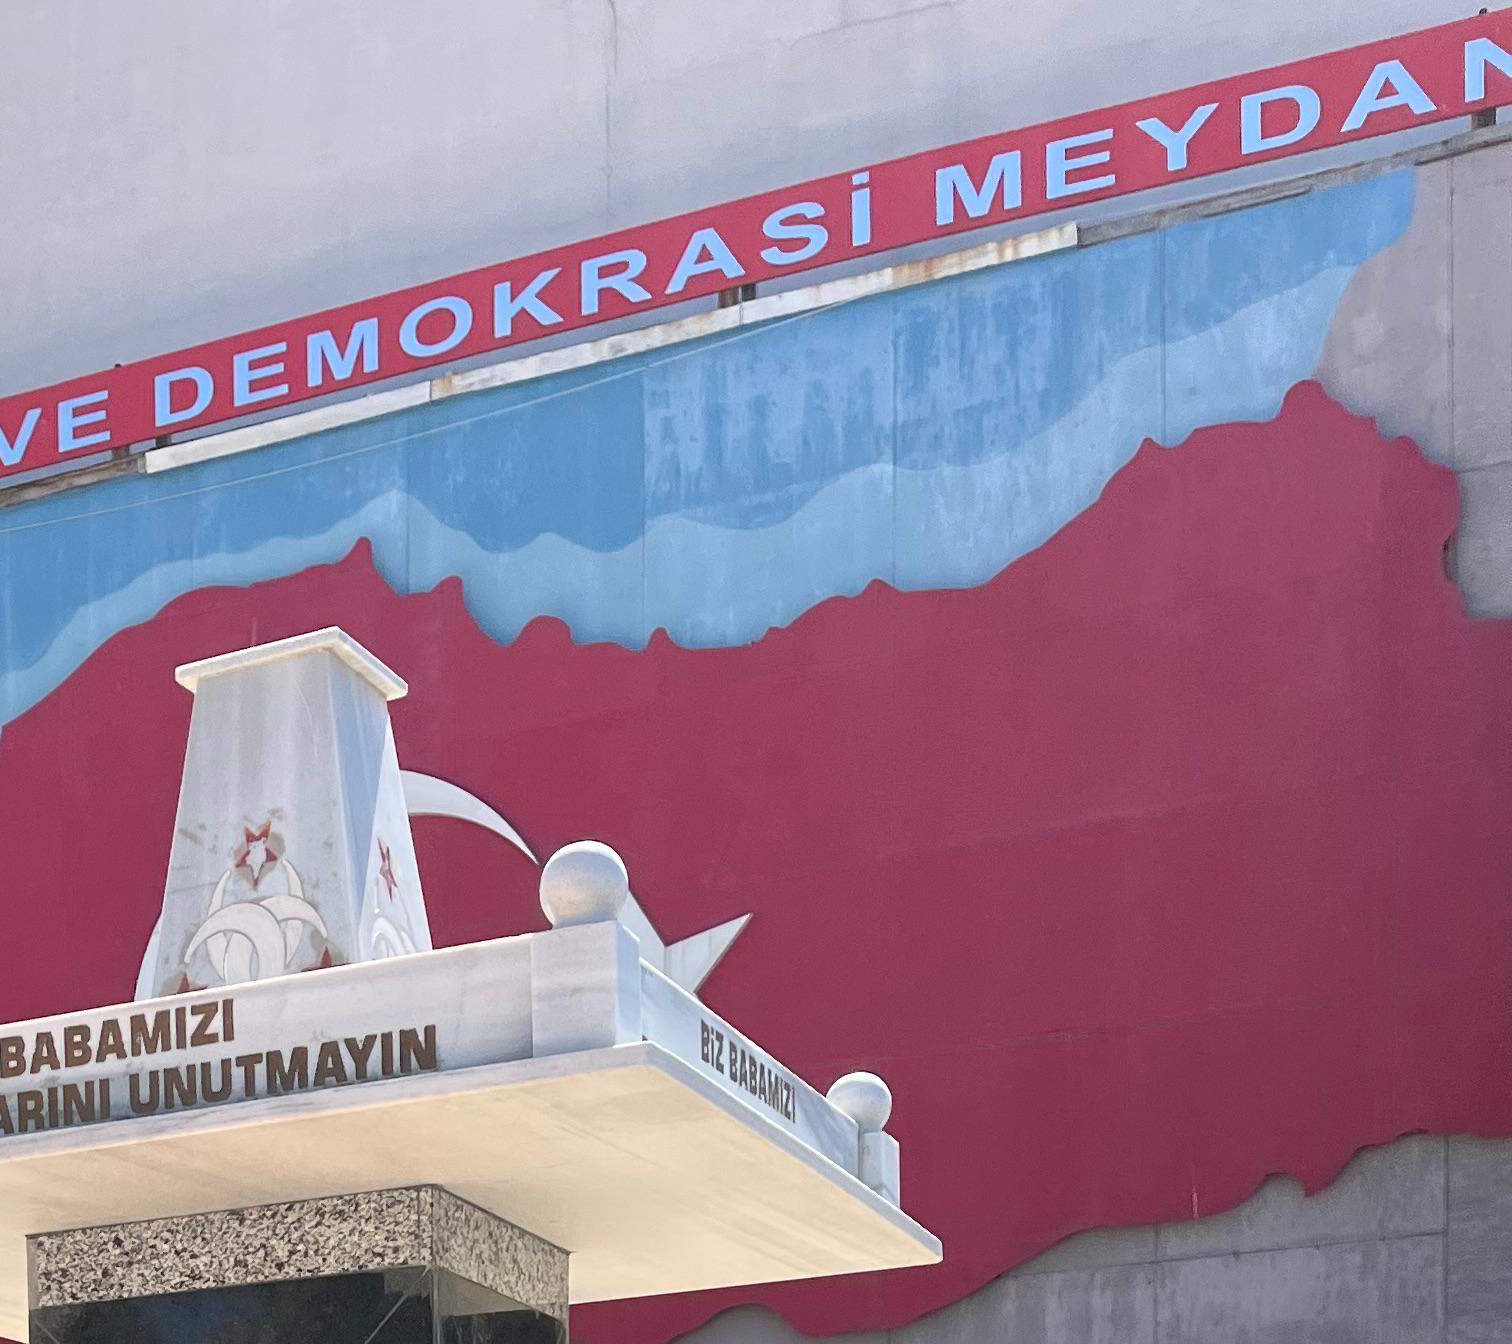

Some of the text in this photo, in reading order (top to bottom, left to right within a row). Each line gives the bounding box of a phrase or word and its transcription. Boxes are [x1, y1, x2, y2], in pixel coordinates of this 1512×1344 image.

[154, 172, 871, 427] DEMOKRASİ
[0, 998, 235, 1079] BABAMIZI
[129, 1024, 438, 1115] UNUTMAYIN
[729, 1040, 796, 1124] BABAMIZI
